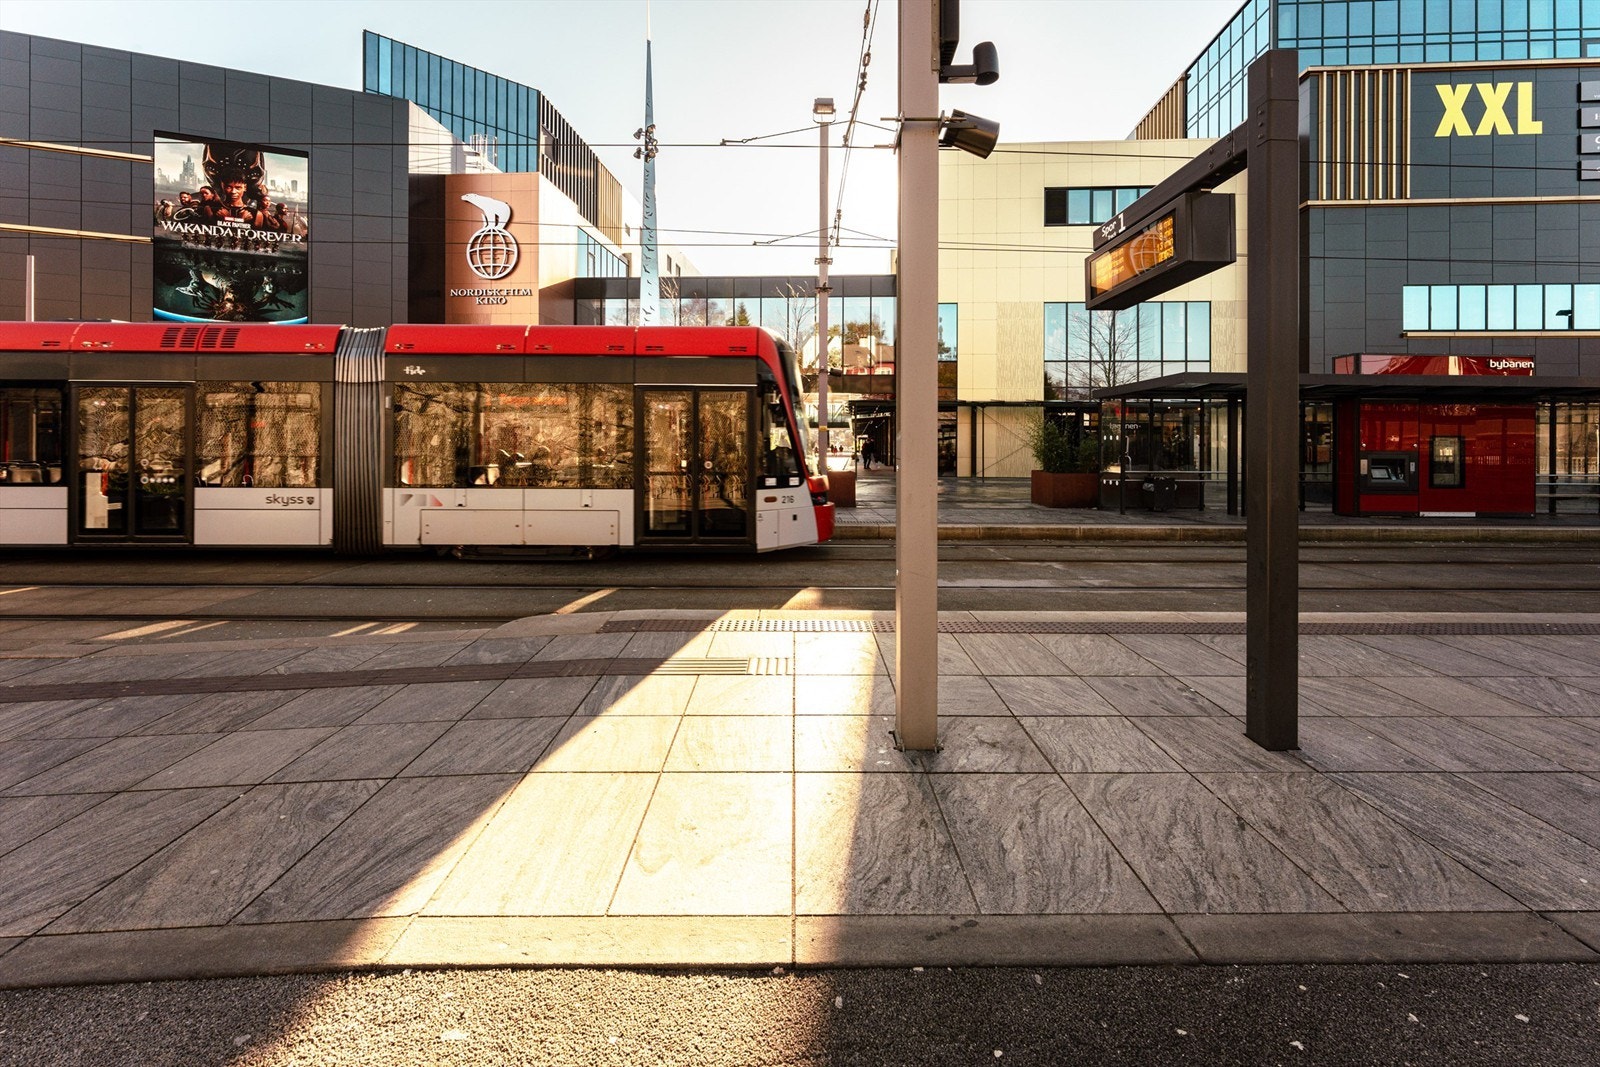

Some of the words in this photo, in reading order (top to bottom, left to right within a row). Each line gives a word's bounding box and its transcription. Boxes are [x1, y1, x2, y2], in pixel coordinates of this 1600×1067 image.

[1434, 81, 1543, 137] XXL
[161, 220, 233, 237] WAKANDA
[237, 228, 302, 242] FOREVER
[1101, 221, 1117, 237] Spor
[1118, 213, 1127, 233] 1
[450, 288, 502, 297] NORDISK
[504, 288, 533, 297] FILM
[476, 296, 508, 305] KINO
[1489, 359, 1535, 370] bybanen
[265, 493, 304, 507] skyss
[781, 495, 795, 504] 216
